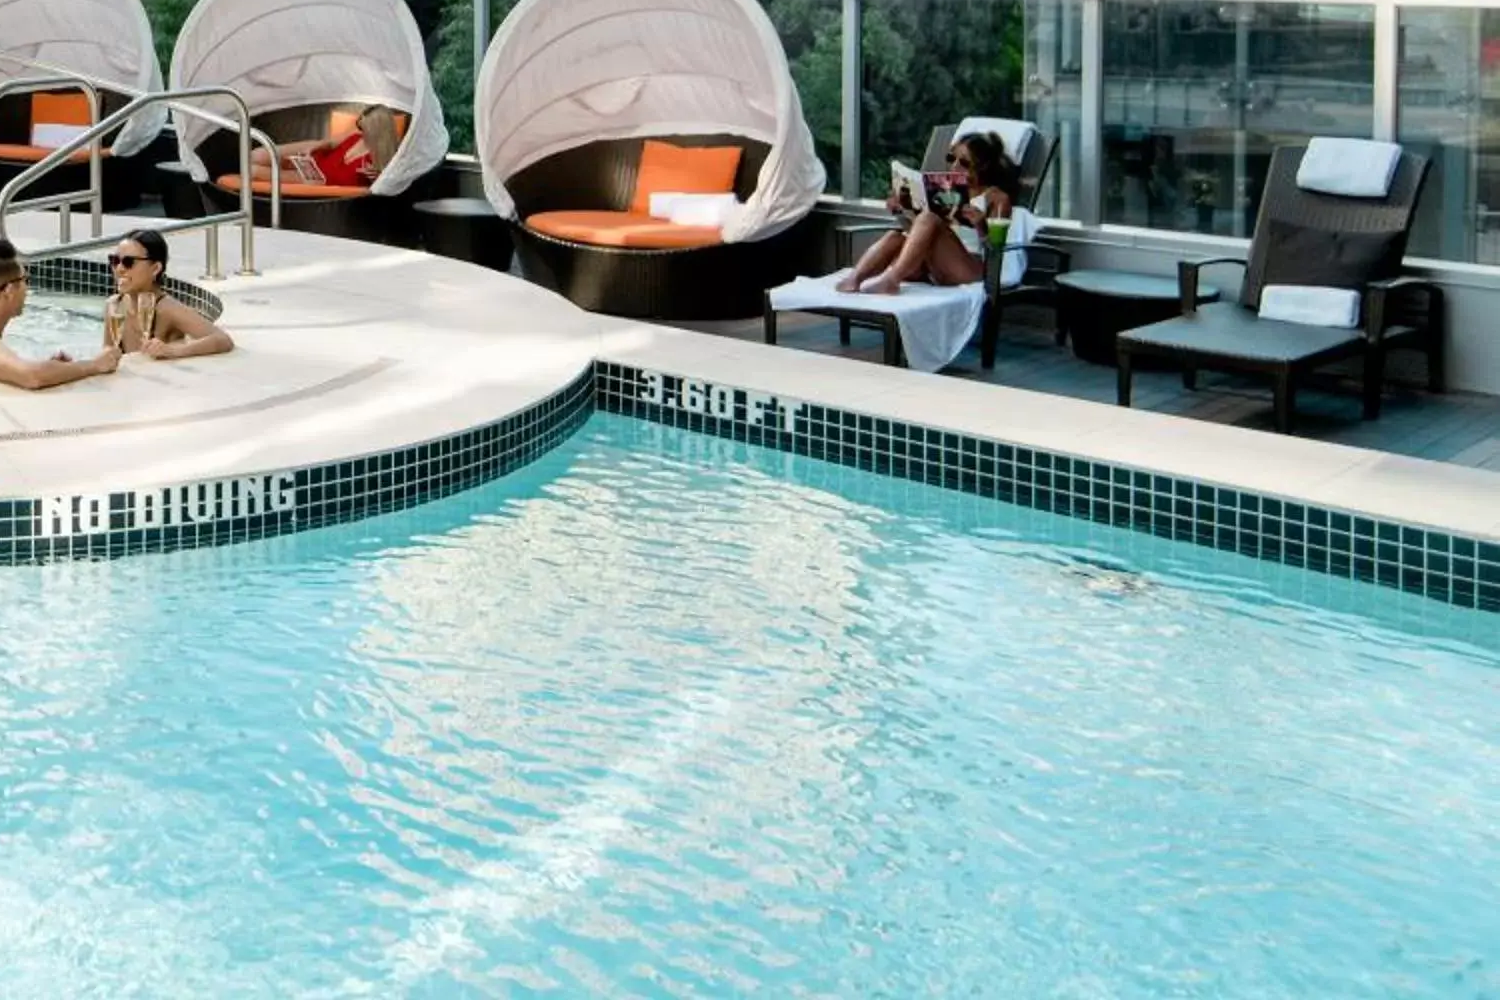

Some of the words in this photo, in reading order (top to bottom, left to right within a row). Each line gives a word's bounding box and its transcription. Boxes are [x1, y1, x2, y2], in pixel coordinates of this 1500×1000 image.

[640, 368, 735, 419] 3.60
[747, 388, 803, 433] FT
[41, 491, 109, 537] NO
[133, 471, 296, 529] DIVING
